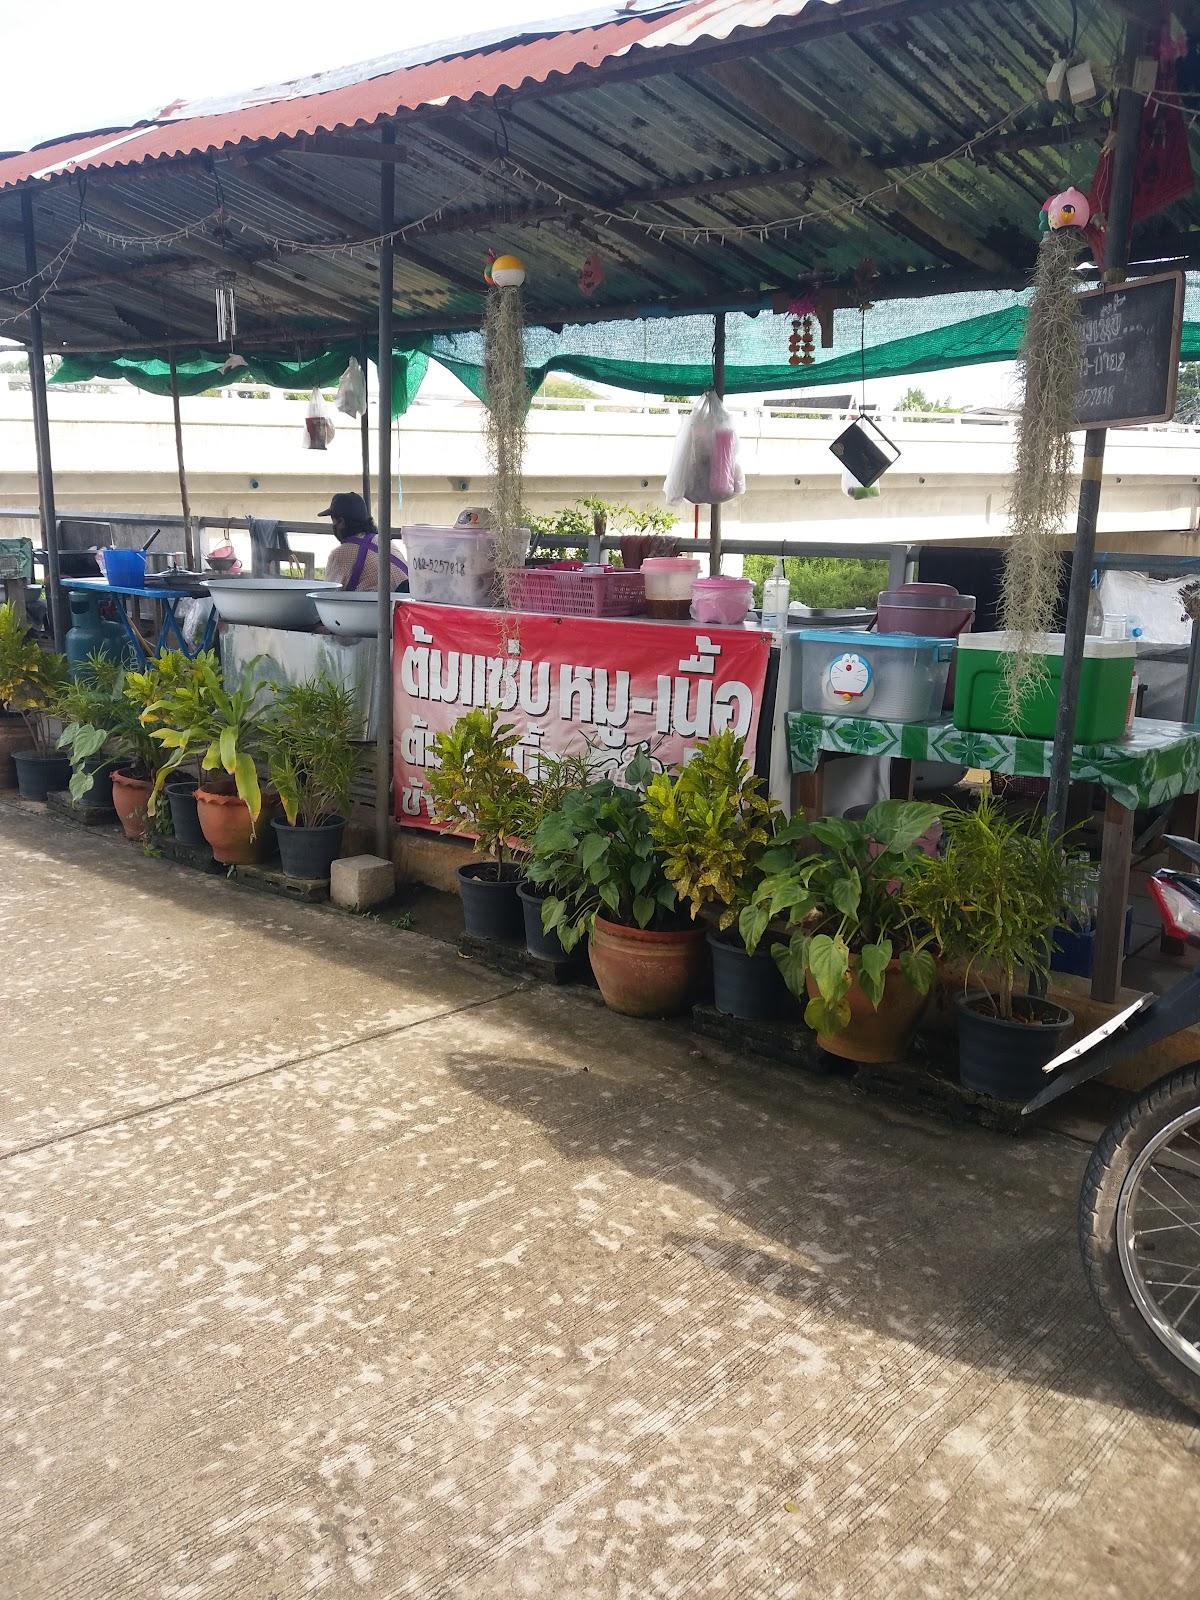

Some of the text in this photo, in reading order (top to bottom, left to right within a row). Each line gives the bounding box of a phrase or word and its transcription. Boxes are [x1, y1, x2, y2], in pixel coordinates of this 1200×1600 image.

[401, 624, 754, 748] ต้มแซ่บ หมู-เนื้อ
